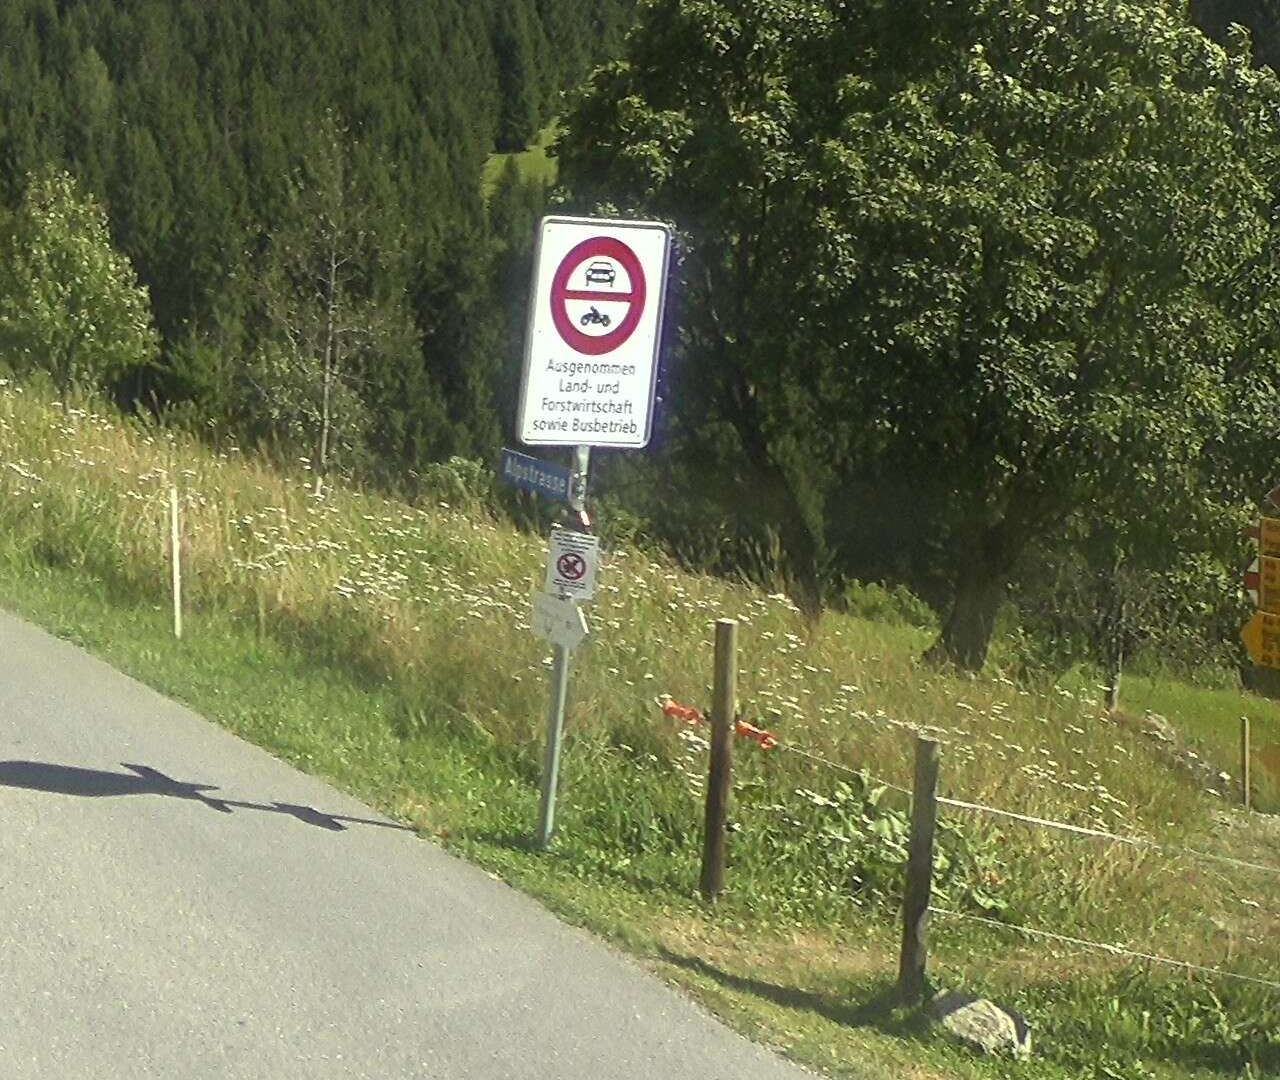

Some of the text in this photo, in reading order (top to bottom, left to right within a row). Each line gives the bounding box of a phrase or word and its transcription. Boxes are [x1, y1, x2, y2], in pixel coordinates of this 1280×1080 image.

[545, 359, 635, 376] Ausgenommen
[559, 379, 620, 394] Land- und
[542, 397, 632, 414] Forstwirtschaft
[533, 417, 637, 434] sowie Busbetrieb
